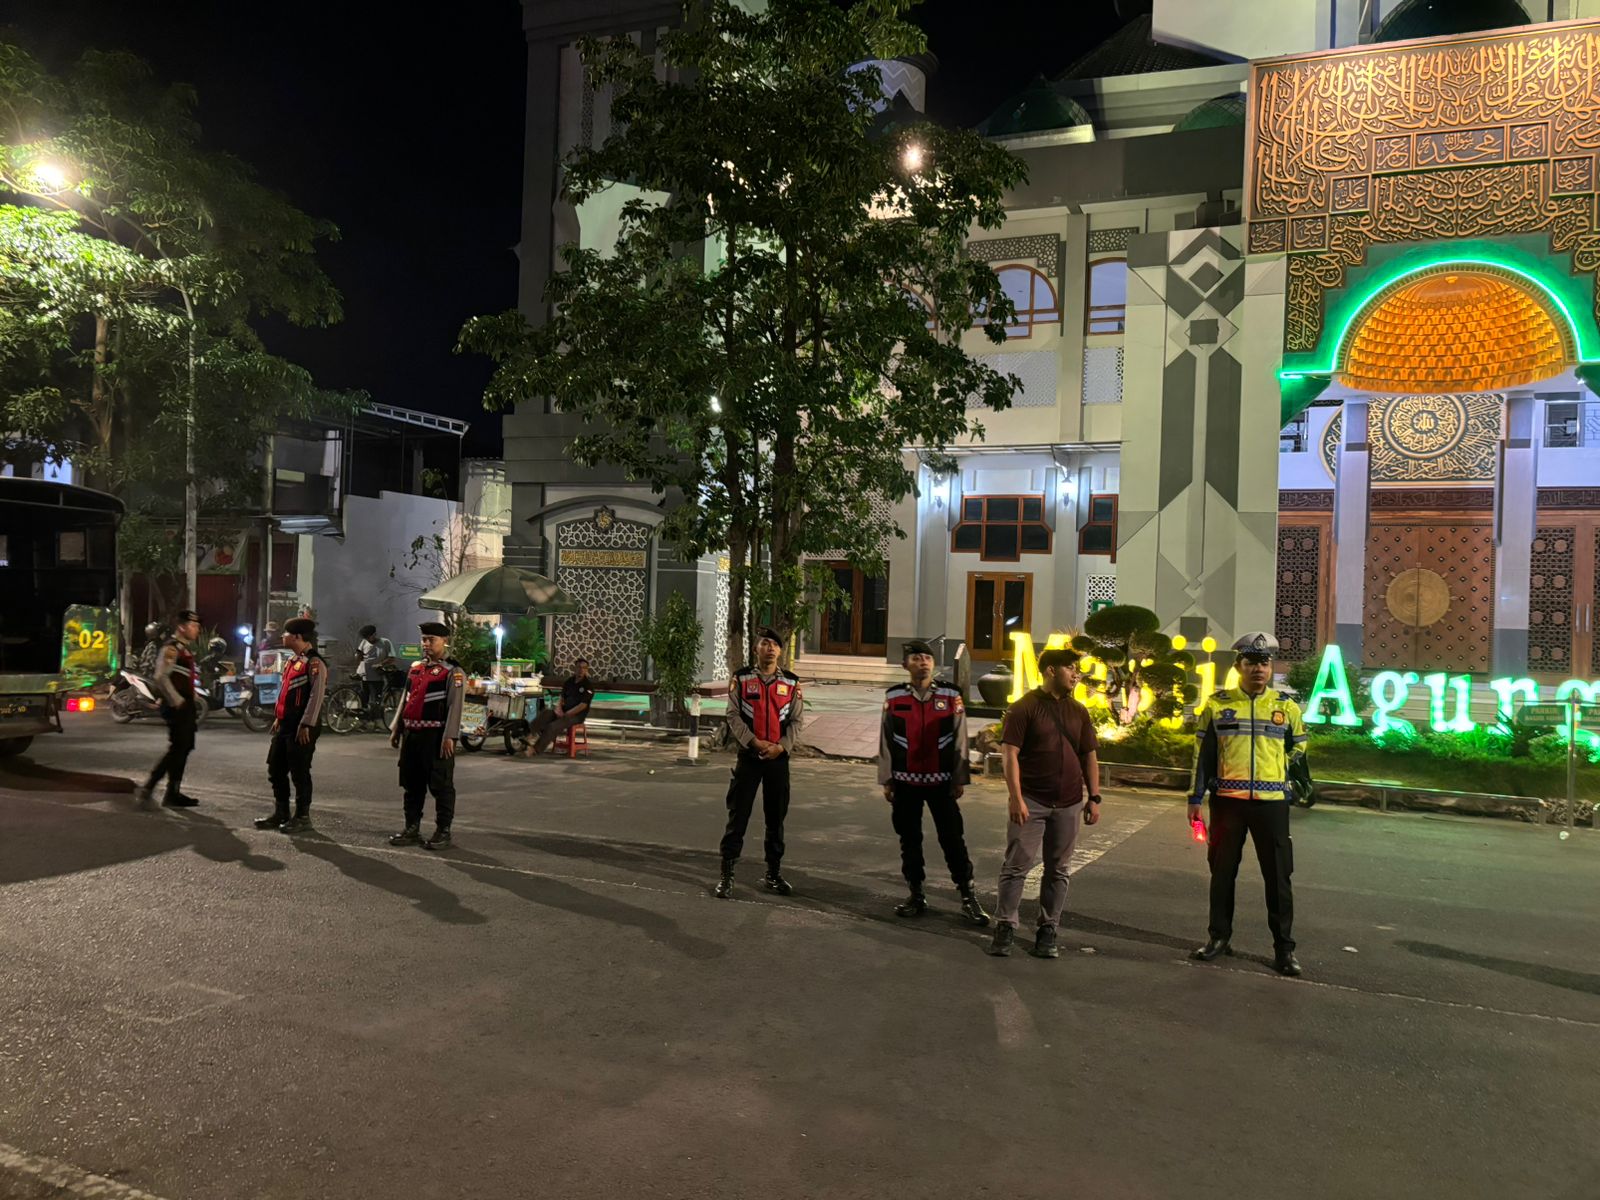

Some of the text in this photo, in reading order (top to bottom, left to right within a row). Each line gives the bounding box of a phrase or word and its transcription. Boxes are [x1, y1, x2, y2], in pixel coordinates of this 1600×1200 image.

[78, 629, 105, 649] 02
[1006, 631, 1600, 762] Maji Agung
